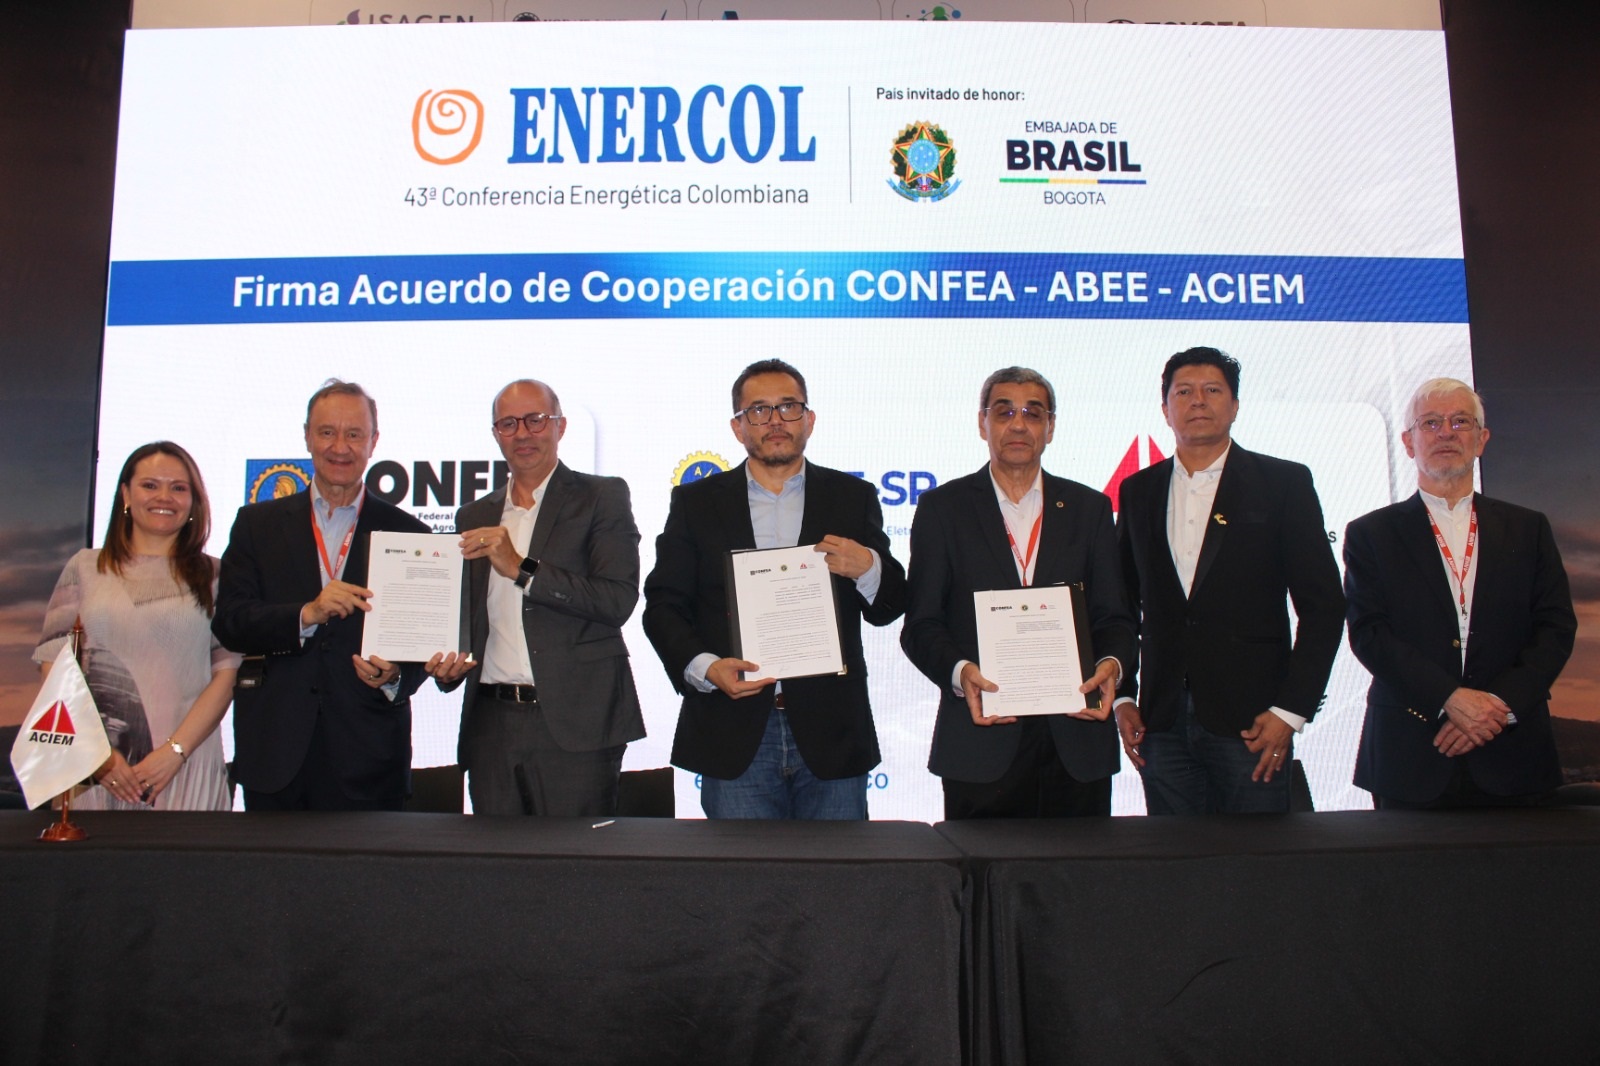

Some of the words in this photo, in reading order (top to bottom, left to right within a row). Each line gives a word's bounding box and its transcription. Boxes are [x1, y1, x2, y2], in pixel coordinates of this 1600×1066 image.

[906, 87, 960, 101] invitado
[963, 87, 980, 101] de
[982, 88, 1026, 102] honor:
[507, 84, 817, 165] ENERCOL
[1025, 120, 1098, 135] EMBAJADA
[1100, 121, 1118, 135] DE
[1006, 139, 1142, 173] BRASIL
[443, 186, 565, 207] Conferencia
[570, 185, 682, 210] Energética
[687, 184, 809, 204] Colombiana
[1043, 190, 1107, 206] BOGOTA
[234, 275, 339, 307] Firma
[349, 273, 512, 306] Acuerdo
[523, 272, 570, 303] de
[582, 268, 834, 309] Cooperación
[847, 270, 1015, 301] CONFEA
[1048, 271, 1148, 302] ABEE
[1182, 272, 1304, 304] ACIEM
[418, 512, 453, 520] Federal
[432, 523, 455, 531] Agro
[29, 731, 74, 746] ACIEM
